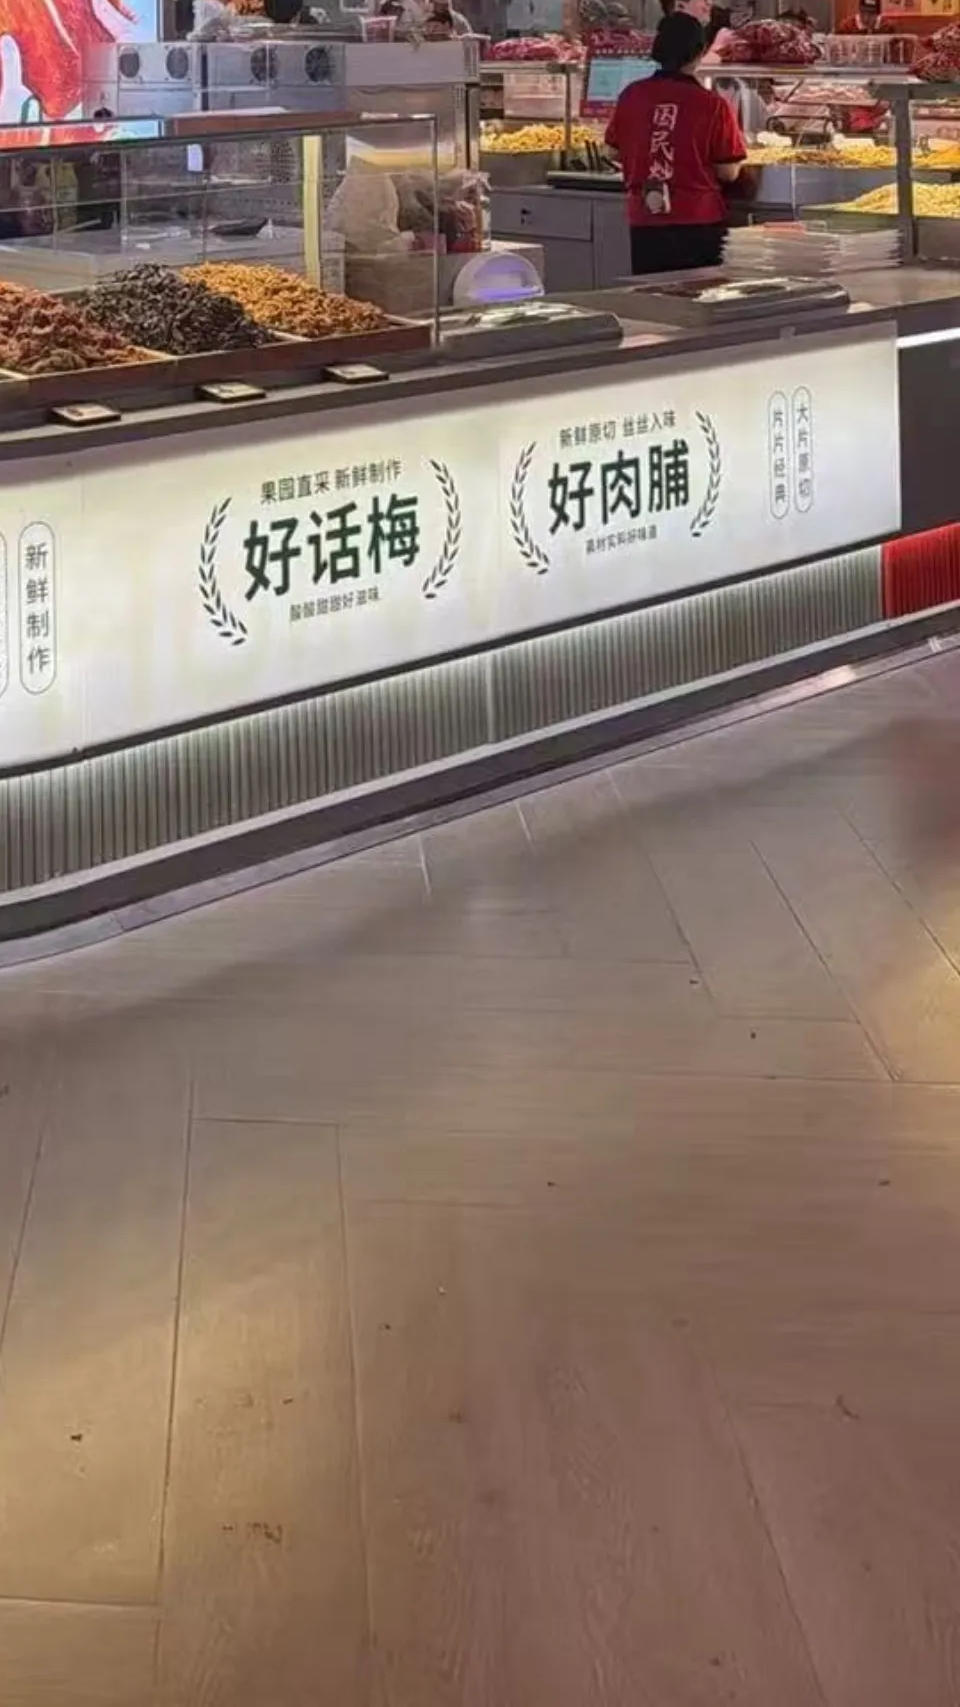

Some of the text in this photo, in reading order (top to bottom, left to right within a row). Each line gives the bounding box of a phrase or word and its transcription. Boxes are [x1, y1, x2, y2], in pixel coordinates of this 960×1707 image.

[559, 410, 677, 449] 新鲜原切 丝丝入味
[260, 459, 403, 505] 果园直采 新鲜制作
[547, 439, 691, 535] 好肉脯
[243, 493, 422, 601] 好话梅
[25, 542, 50, 676] 新鲜制作
